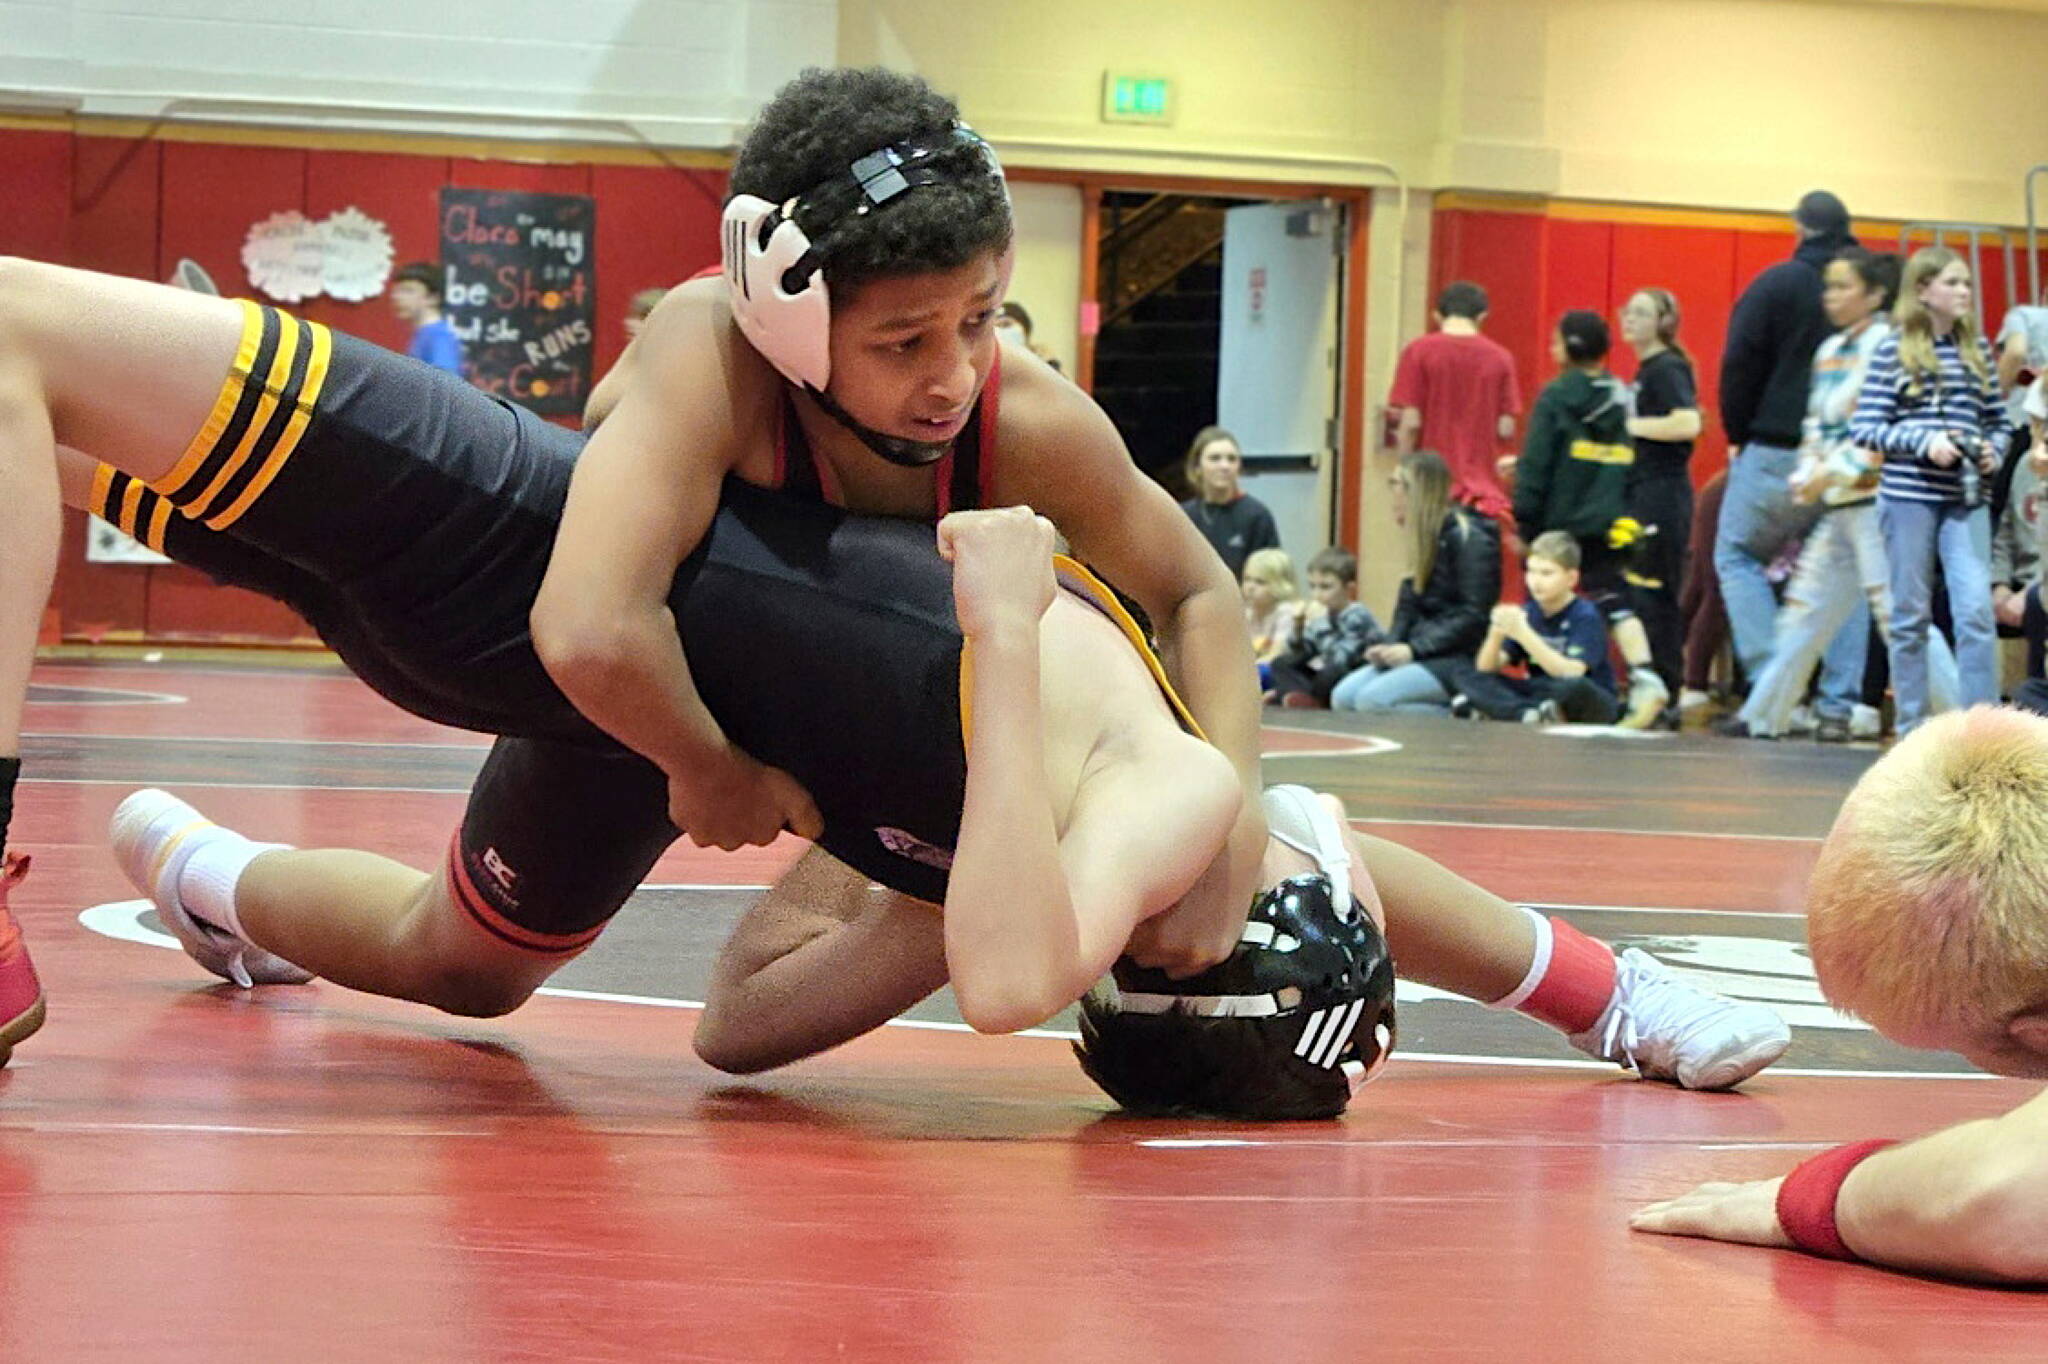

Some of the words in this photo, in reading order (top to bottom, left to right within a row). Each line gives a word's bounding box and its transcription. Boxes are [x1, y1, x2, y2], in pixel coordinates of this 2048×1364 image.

[530, 226, 584, 264] may
[445, 264, 490, 306] be
[494, 264, 586, 311] Short
[523, 319, 592, 366] RUNS
[484, 846, 517, 889] BC
